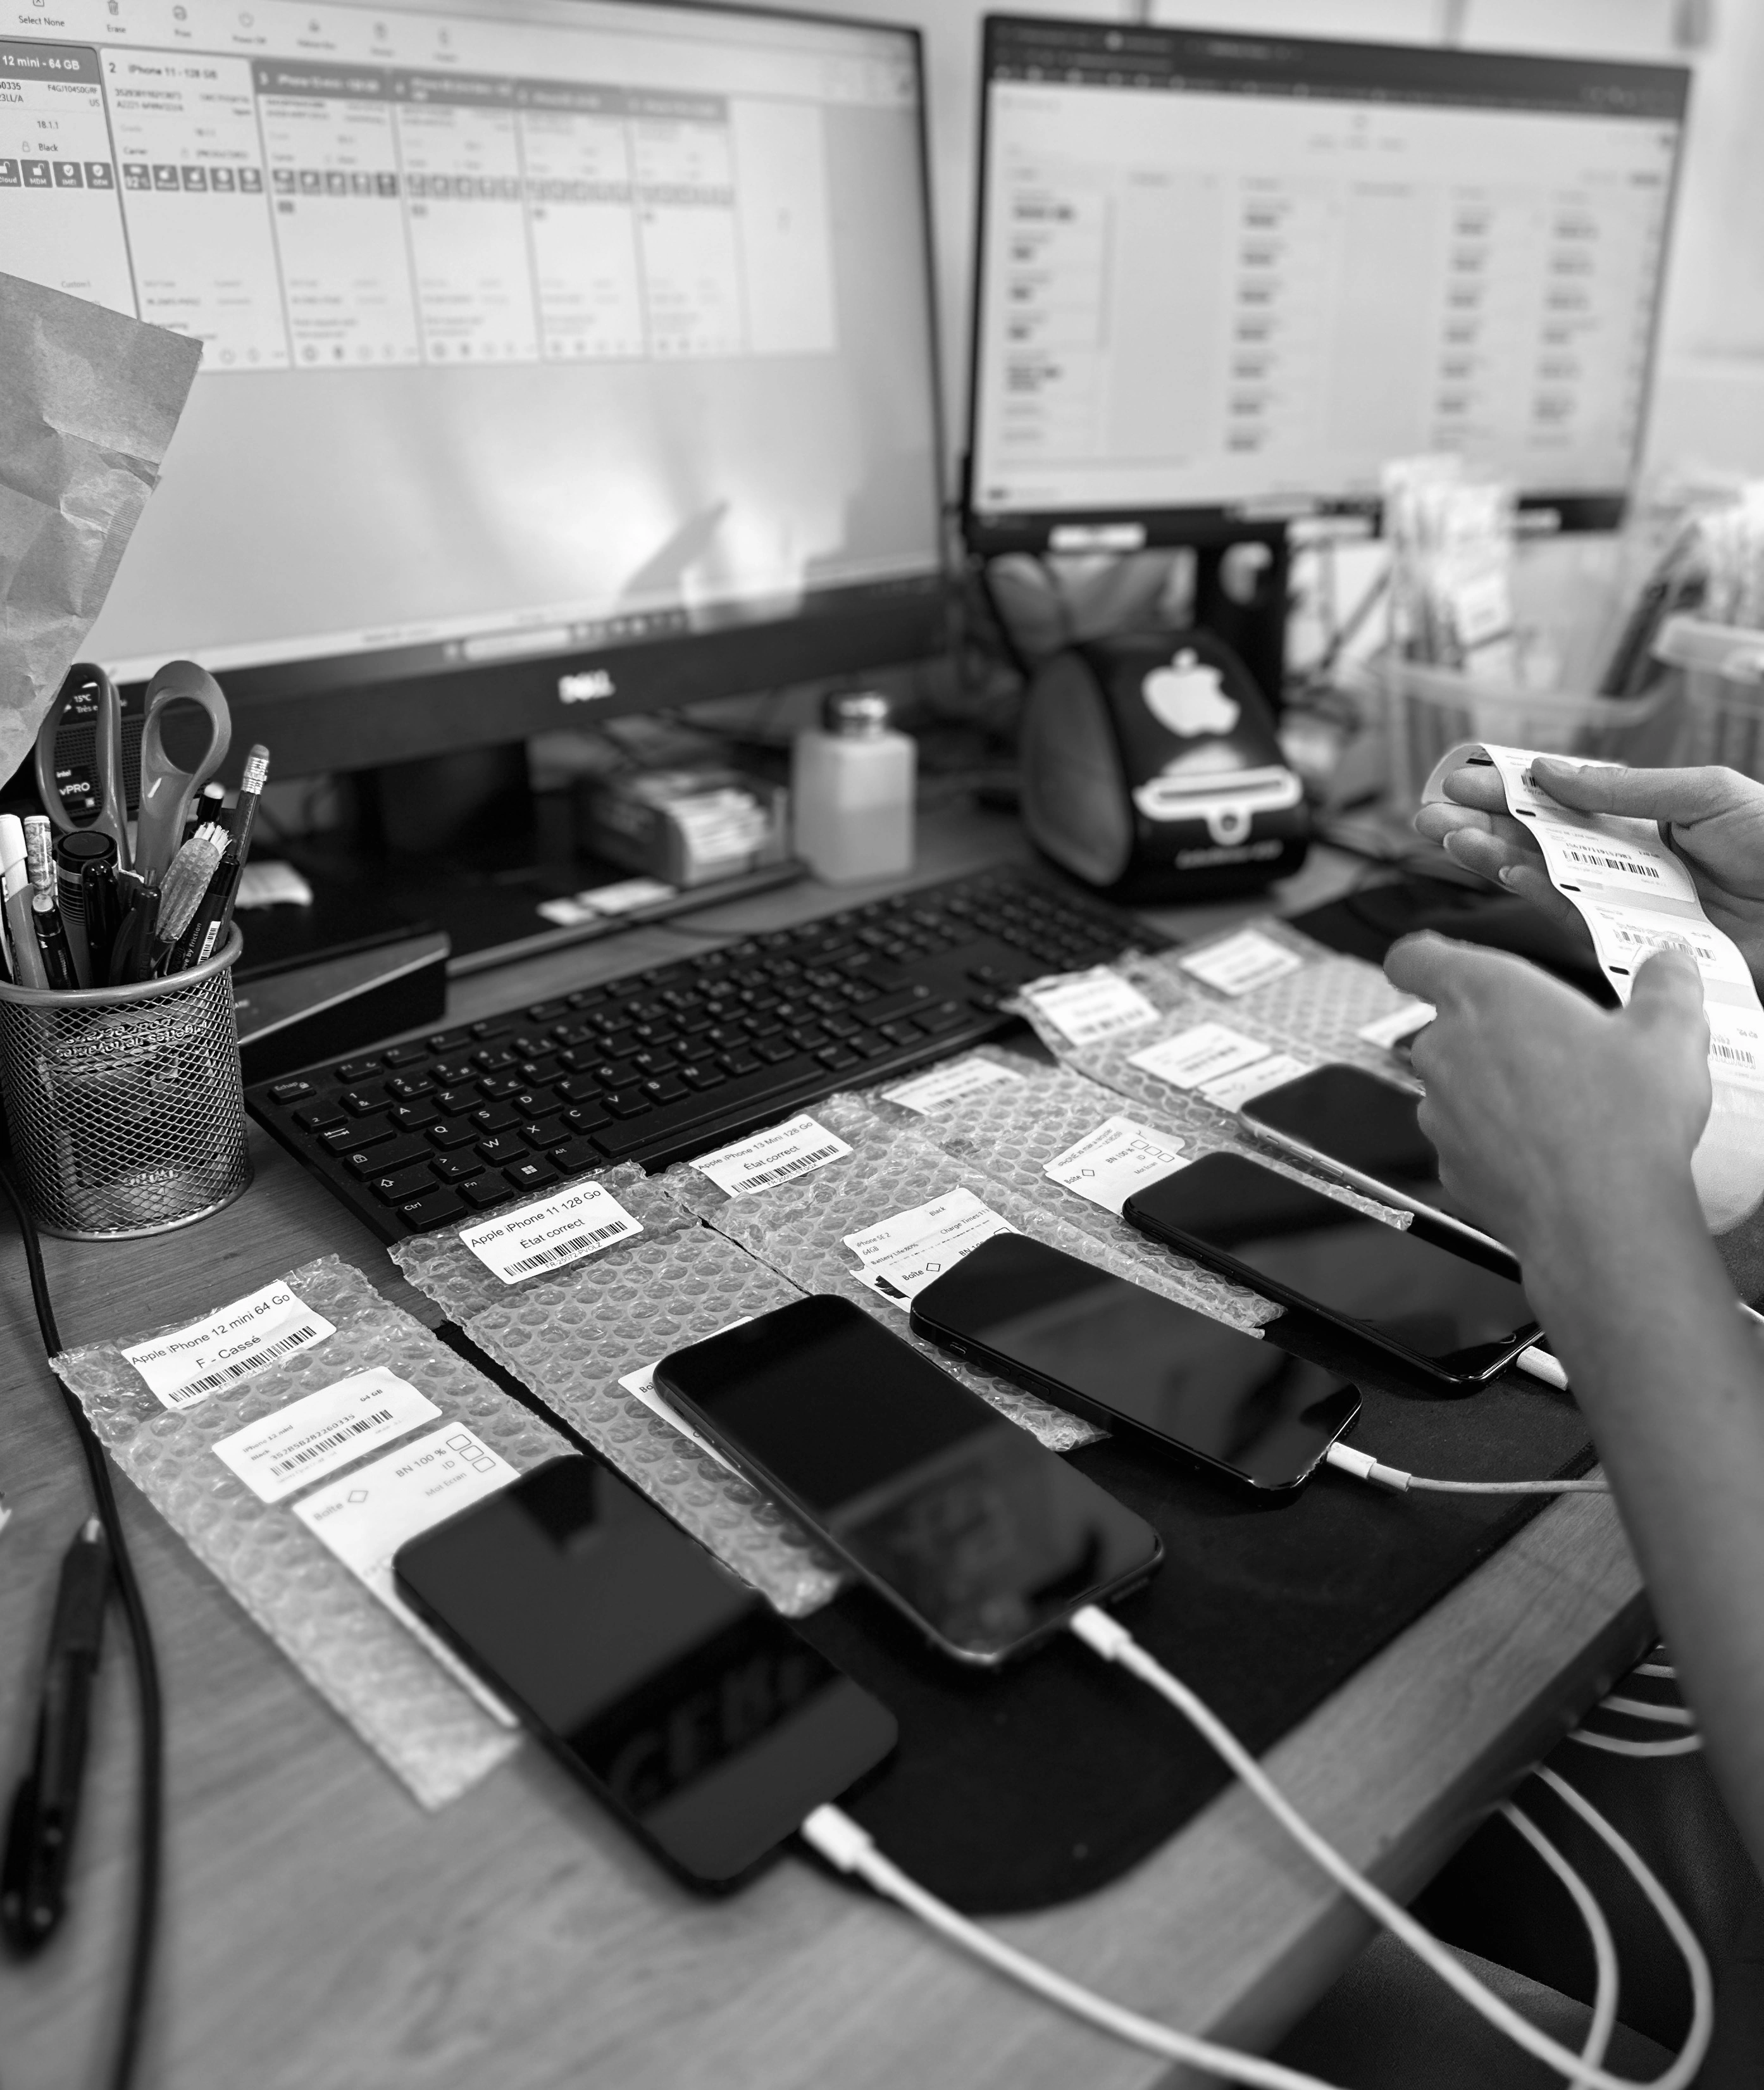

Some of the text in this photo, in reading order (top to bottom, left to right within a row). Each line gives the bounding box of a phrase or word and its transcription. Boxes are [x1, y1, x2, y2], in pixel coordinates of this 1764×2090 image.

[18, 15, 65, 27] Select None
[107, 25, 127, 33] Erase
[2, 55, 15, 66] 12
[17, 57, 40, 68] mini
[49, 59, 61, 69] 64
[63, 60, 80, 70] GB
[109, 62, 116, 73] 2
[37, 121, 59, 129] 18.1.1
[39, 143, 58, 152] Black
[59, 782, 90, 795] vPRO
[189, 923, 202, 947] friction
[186, 949, 194, 957] by
[483, 1078, 496, 1086] E
[526, 1125, 540, 1133] X
[483, 1139, 499, 1148] W
[698, 1159, 723, 1171] Apple
[723, 1148, 753, 1162] iPhone
[764, 1135, 783, 1145] Mini
[783, 1128, 800, 1137] 128
[743, 1145, 800, 1171] État correct
[404, 1202, 422, 1212] Ctrl
[929, 1206, 946, 1217] Black
[471, 1190, 601, 1248] Apple iPhone 11 128 Go
[519, 1218, 586, 1249] État correct
[856, 1236, 878, 1248] iPhone
[871, 1254, 893, 1266] Battery
[940, 1222, 962, 1235] Charge
[902, 1269, 924, 1281] Boîte
[130, 1294, 290, 1365] Apple iPhone 12 mini 64 Go
[196, 1359, 205, 1369] F
[218, 1336, 262, 1359] Cassé
[371, 1389, 383, 1397] GB
[268, 1433, 278, 1441] 12
[250, 1449, 271, 1461] Black
[395, 1448, 447, 1478] BN 100 %
[442, 1460, 456, 1471] ID
[425, 1472, 468, 1496] Mot Ecran
[313, 1502, 344, 1522] Boîte
